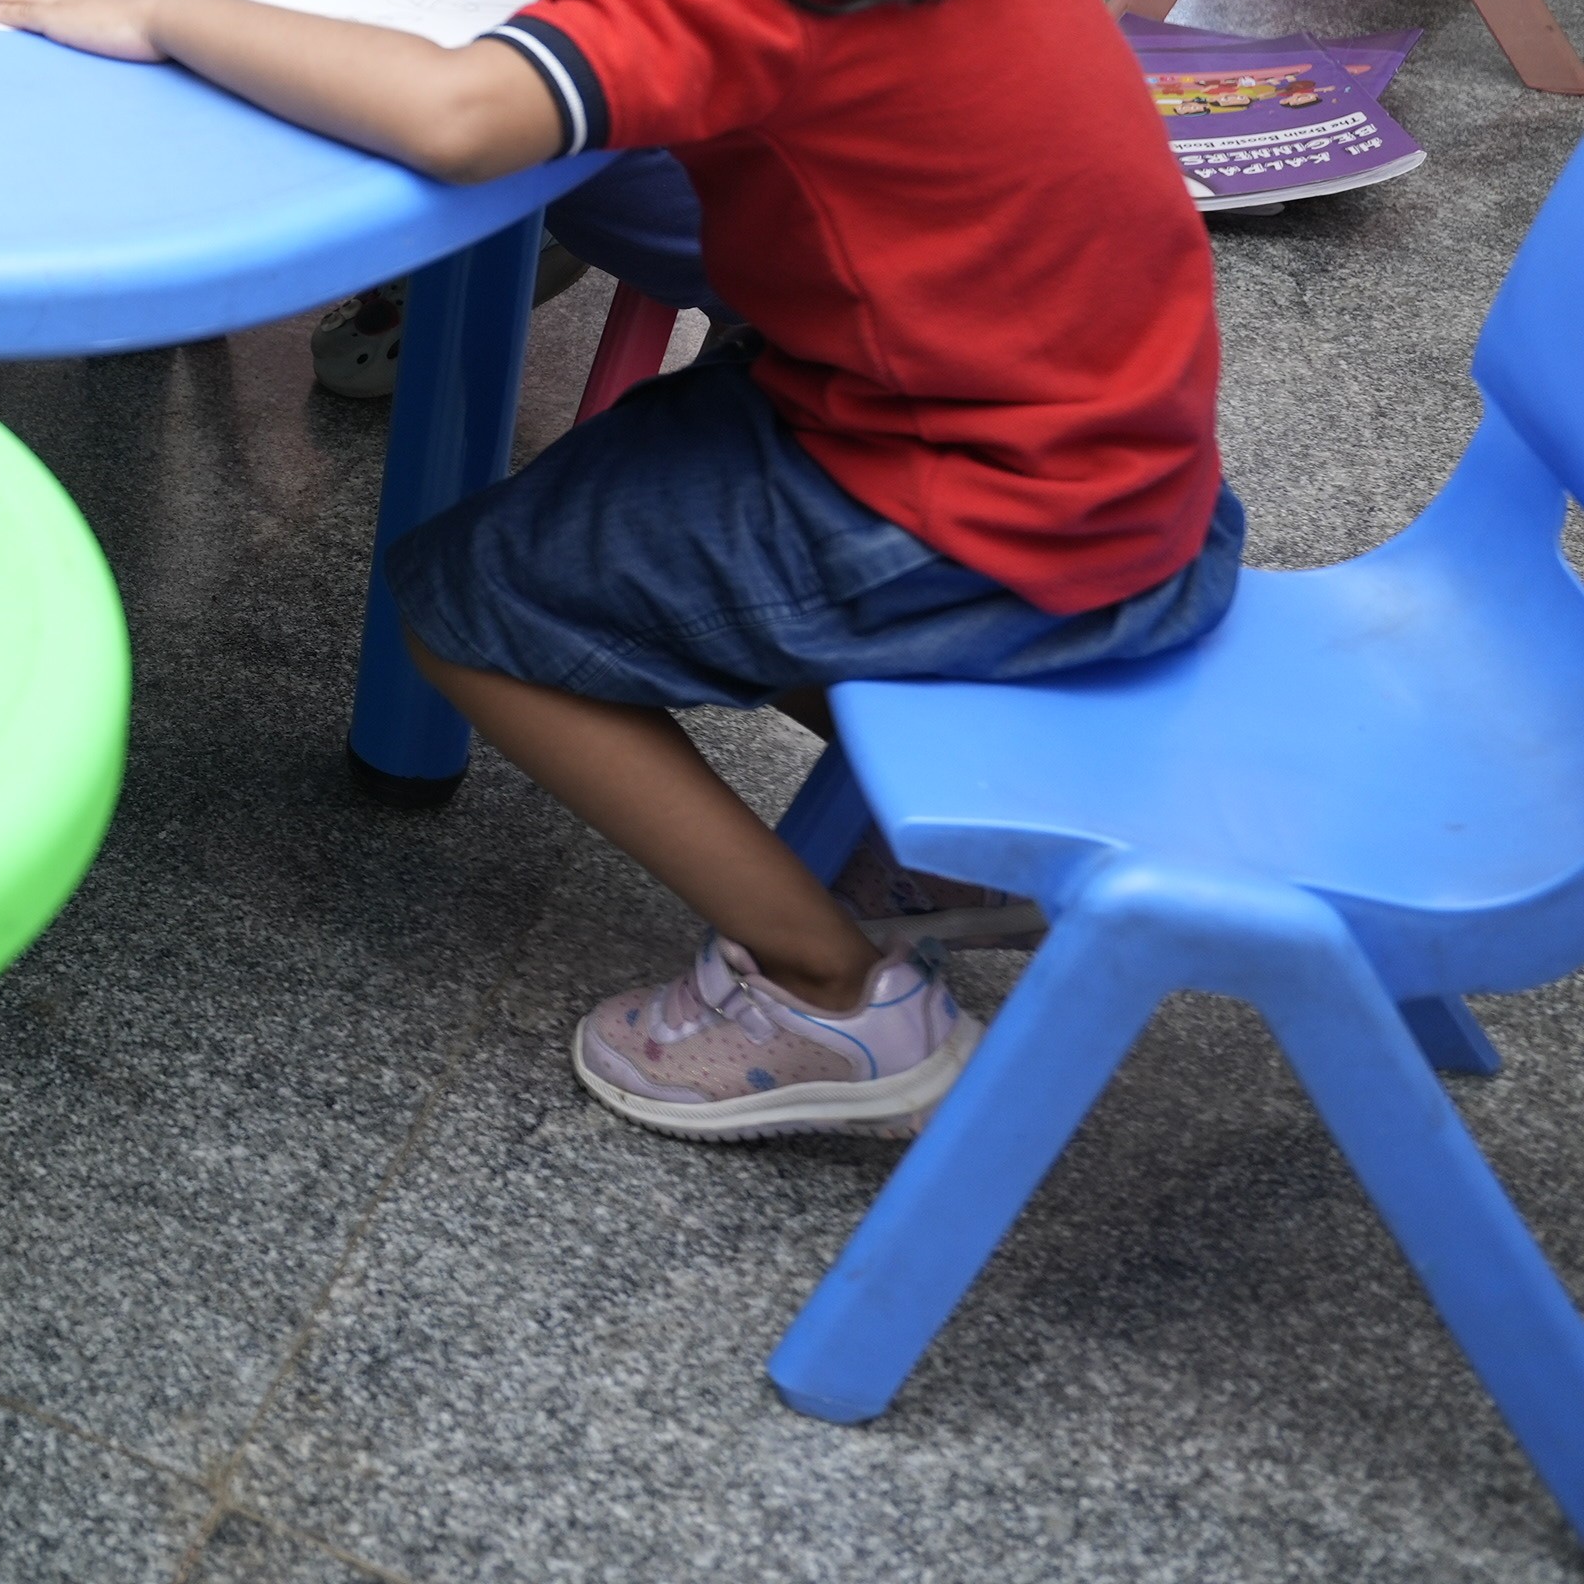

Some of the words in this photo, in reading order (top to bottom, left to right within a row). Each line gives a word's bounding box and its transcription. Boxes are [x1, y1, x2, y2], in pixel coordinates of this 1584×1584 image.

[1331, 117, 1360, 129] The
[1284, 126, 1327, 138] Brain
[1173, 141, 1215, 151] Book
[1179, 123, 1378, 166] BEGINNERS
[1219, 134, 1280, 146] Booster
[1345, 137, 1383, 156] HI
[1194, 151, 1331, 179] KALPAA
